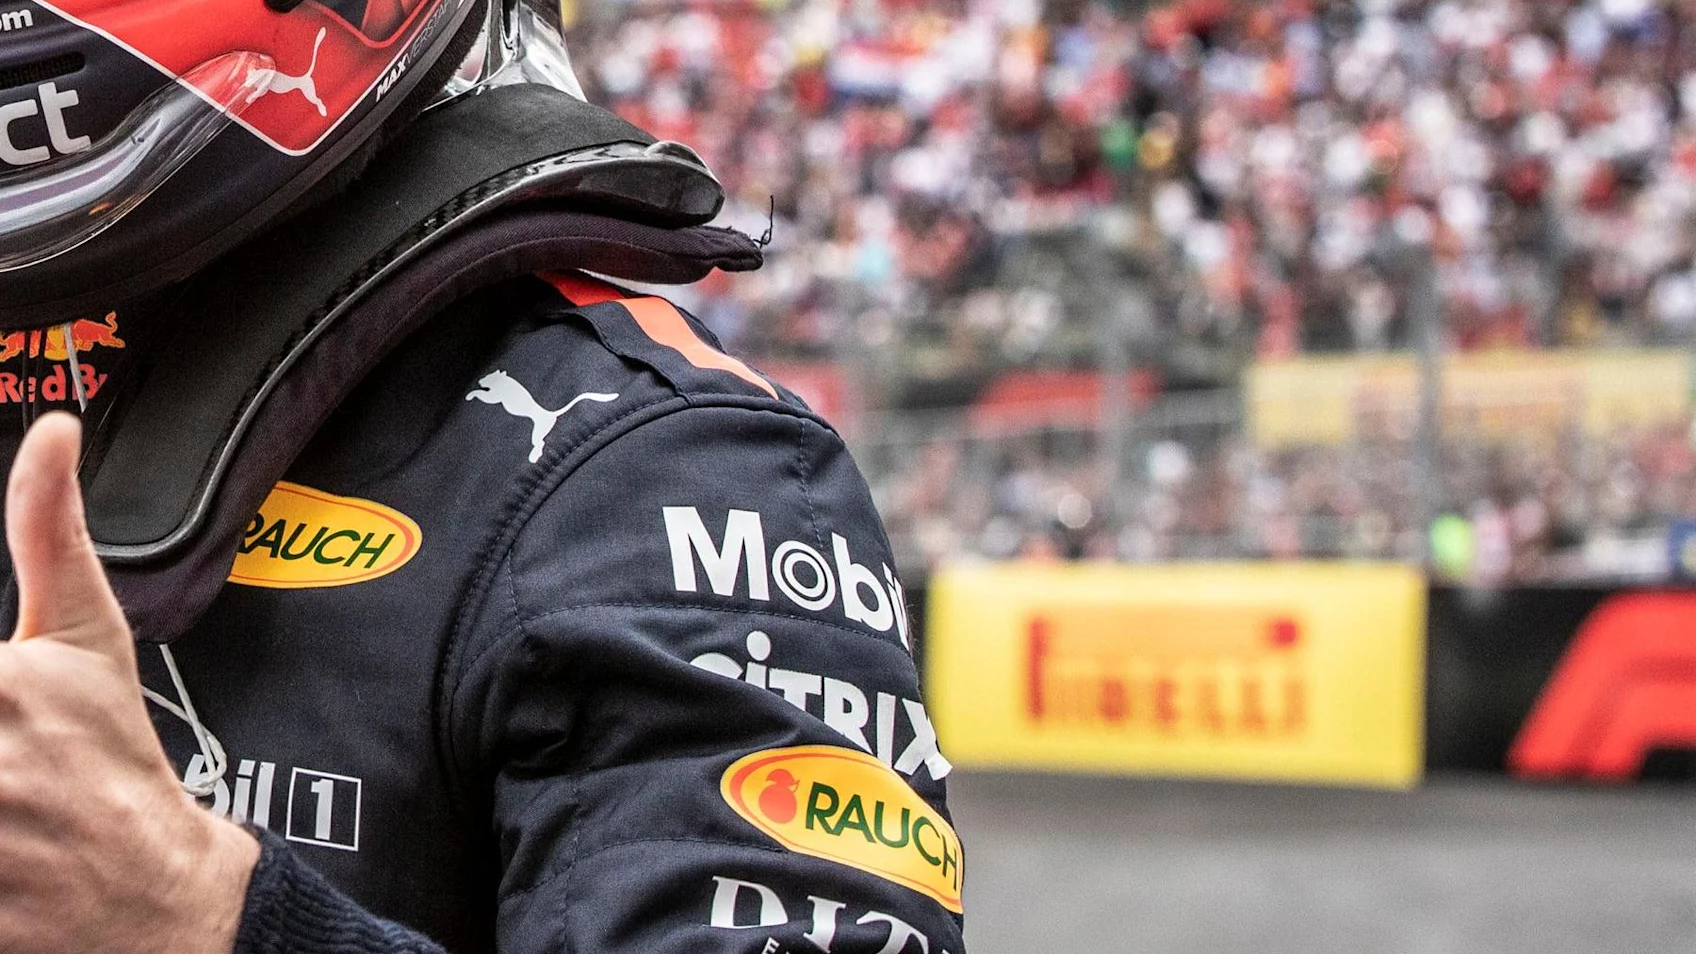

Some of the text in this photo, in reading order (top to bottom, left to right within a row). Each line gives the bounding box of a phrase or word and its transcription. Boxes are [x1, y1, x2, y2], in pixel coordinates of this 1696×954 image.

[184, 754, 276, 829] bil
[805, 781, 958, 892] RAUCH
[710, 875, 950, 954] DIT
